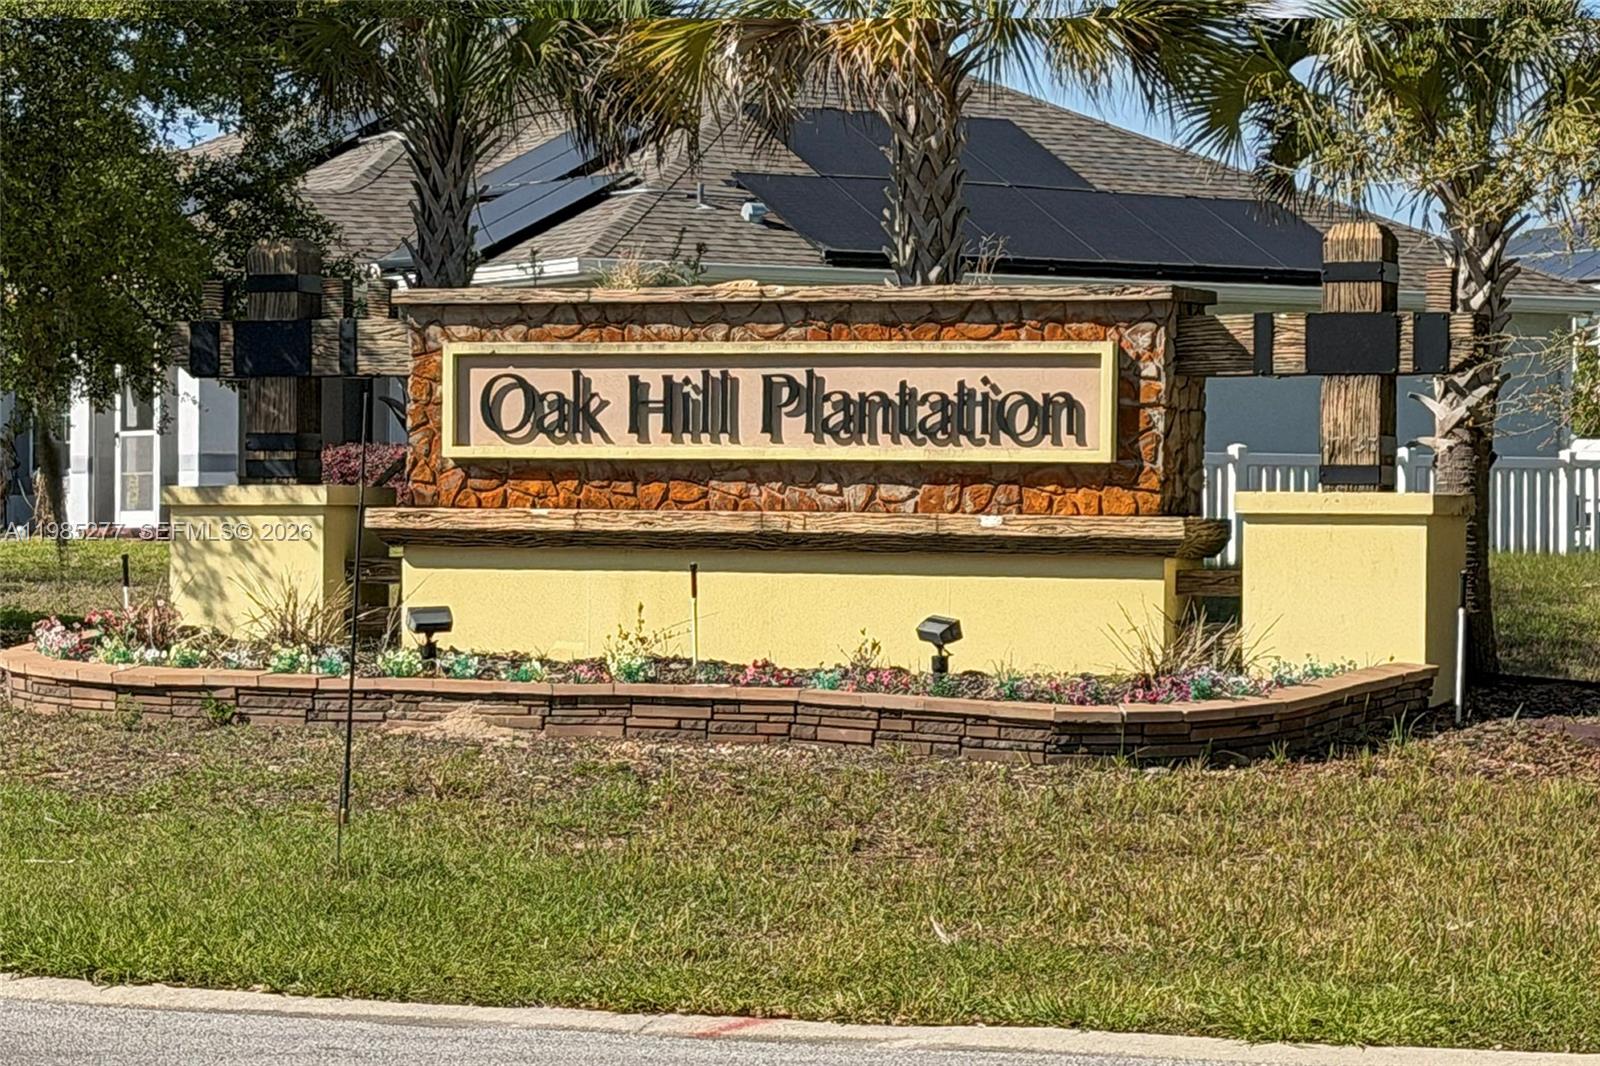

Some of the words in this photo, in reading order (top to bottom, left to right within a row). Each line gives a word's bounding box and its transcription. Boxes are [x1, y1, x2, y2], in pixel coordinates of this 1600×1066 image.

[480, 370, 609, 436] Oak
[628, 369, 732, 436] Hill
[761, 369, 1077, 437] Plantation
